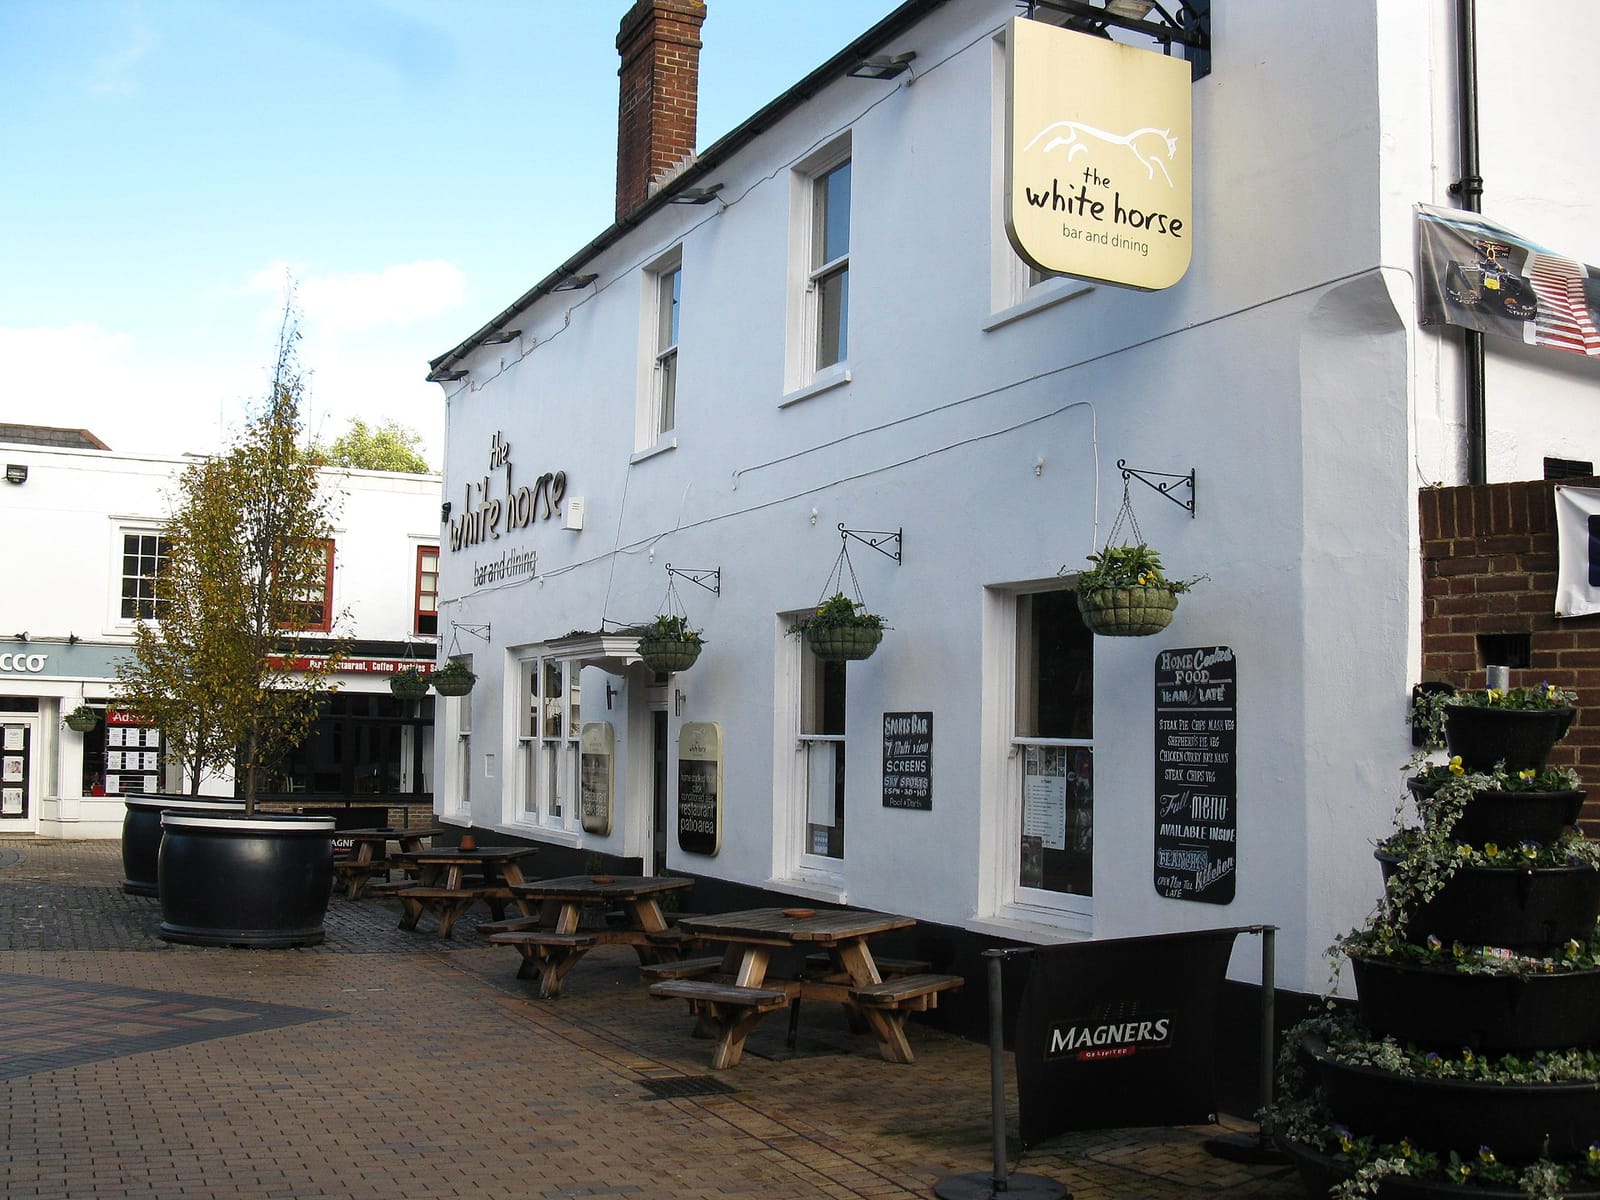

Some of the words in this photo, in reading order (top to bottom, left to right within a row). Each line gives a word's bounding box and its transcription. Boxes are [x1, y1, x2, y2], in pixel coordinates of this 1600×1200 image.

[1083, 167, 1110, 188] the
[1026, 179, 1105, 221] white
[1114, 192, 1183, 237] horse
[1063, 223, 1082, 239] bar
[1086, 231, 1108, 245] and
[1111, 234, 1149, 256] dining
[489, 430, 510, 470] the
[449, 476, 501, 552] white
[505, 462, 567, 532] horse
[474, 560, 487, 587] bar
[488, 550, 505, 583] and
[506, 545, 538, 578] dining
[372, 662, 394, 671] Coffee
[1175, 670, 1210, 685] FOOD
[886, 760, 927, 772] SCREENS
[1160, 823, 1207, 840] AVAILABLE
[1209, 826, 1236, 842] INSIDE
[1050, 1018, 1170, 1053] MAGNERS
